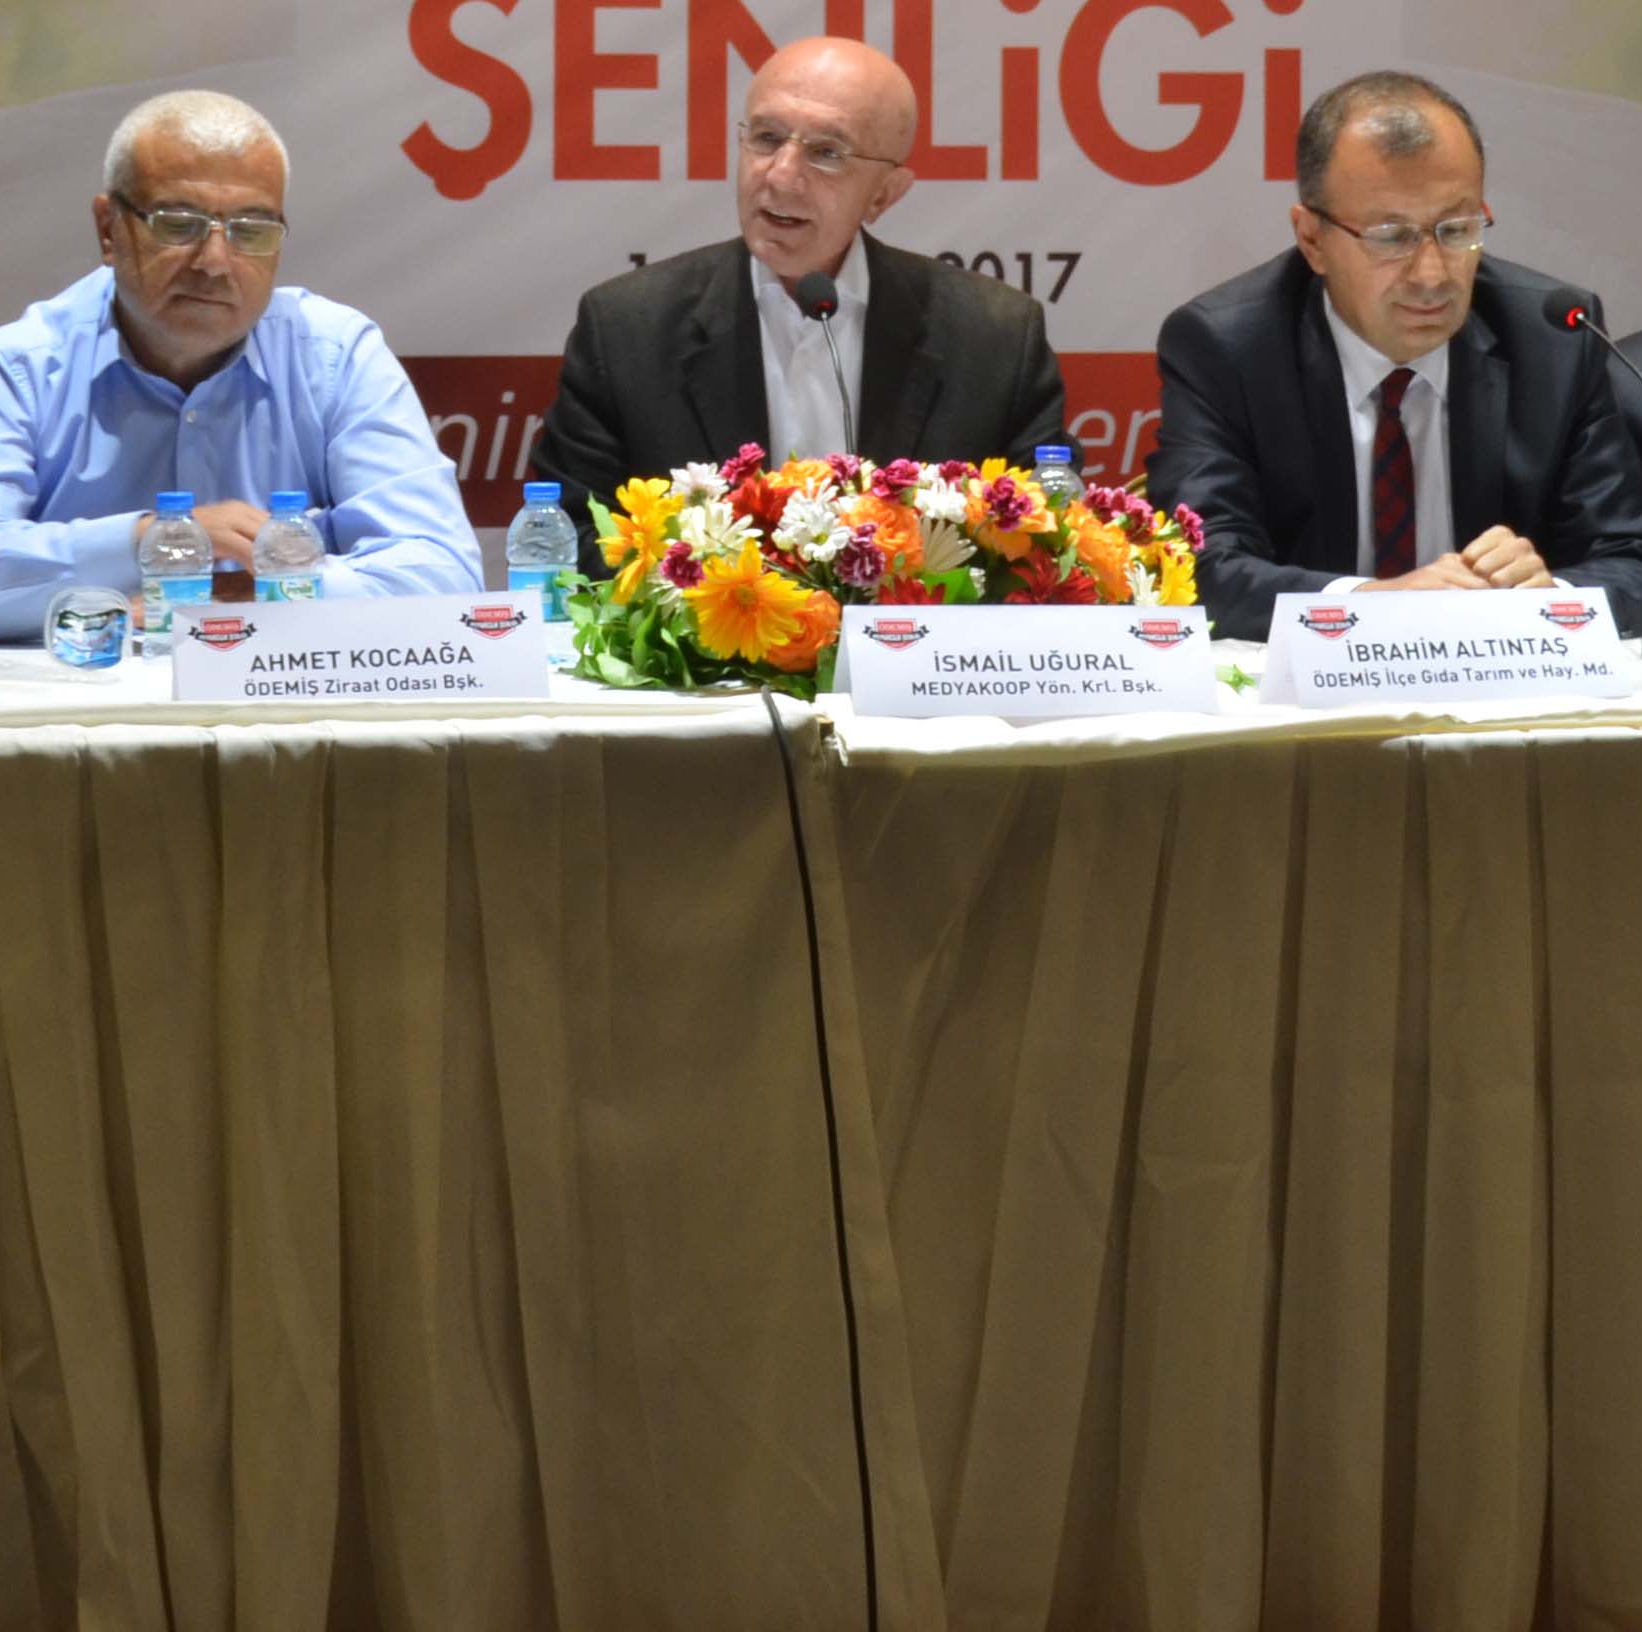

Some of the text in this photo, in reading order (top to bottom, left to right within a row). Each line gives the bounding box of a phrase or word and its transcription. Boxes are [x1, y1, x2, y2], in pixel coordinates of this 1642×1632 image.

[250, 641, 475, 673] AHMET KOCAAĞA
[933, 647, 1135, 674] İSMAİL UĞURAL
[1347, 635, 1569, 663] İBRAHİM ALTINTAŞ
[243, 673, 485, 698] ÖDEMİŞ Ziraat Odası Bşk.
[911, 678, 1162, 697] MEDYAKOOP Yön. Krl. Bşk.
[1313, 668, 1382, 689] ÖDEMİŞ
[1421, 667, 1459, 685] Gıda
[1462, 665, 1515, 683] Tarım
[1519, 667, 1538, 680] ve
[1541, 663, 1580, 683] Hay.
[1583, 661, 1614, 677] Md.
